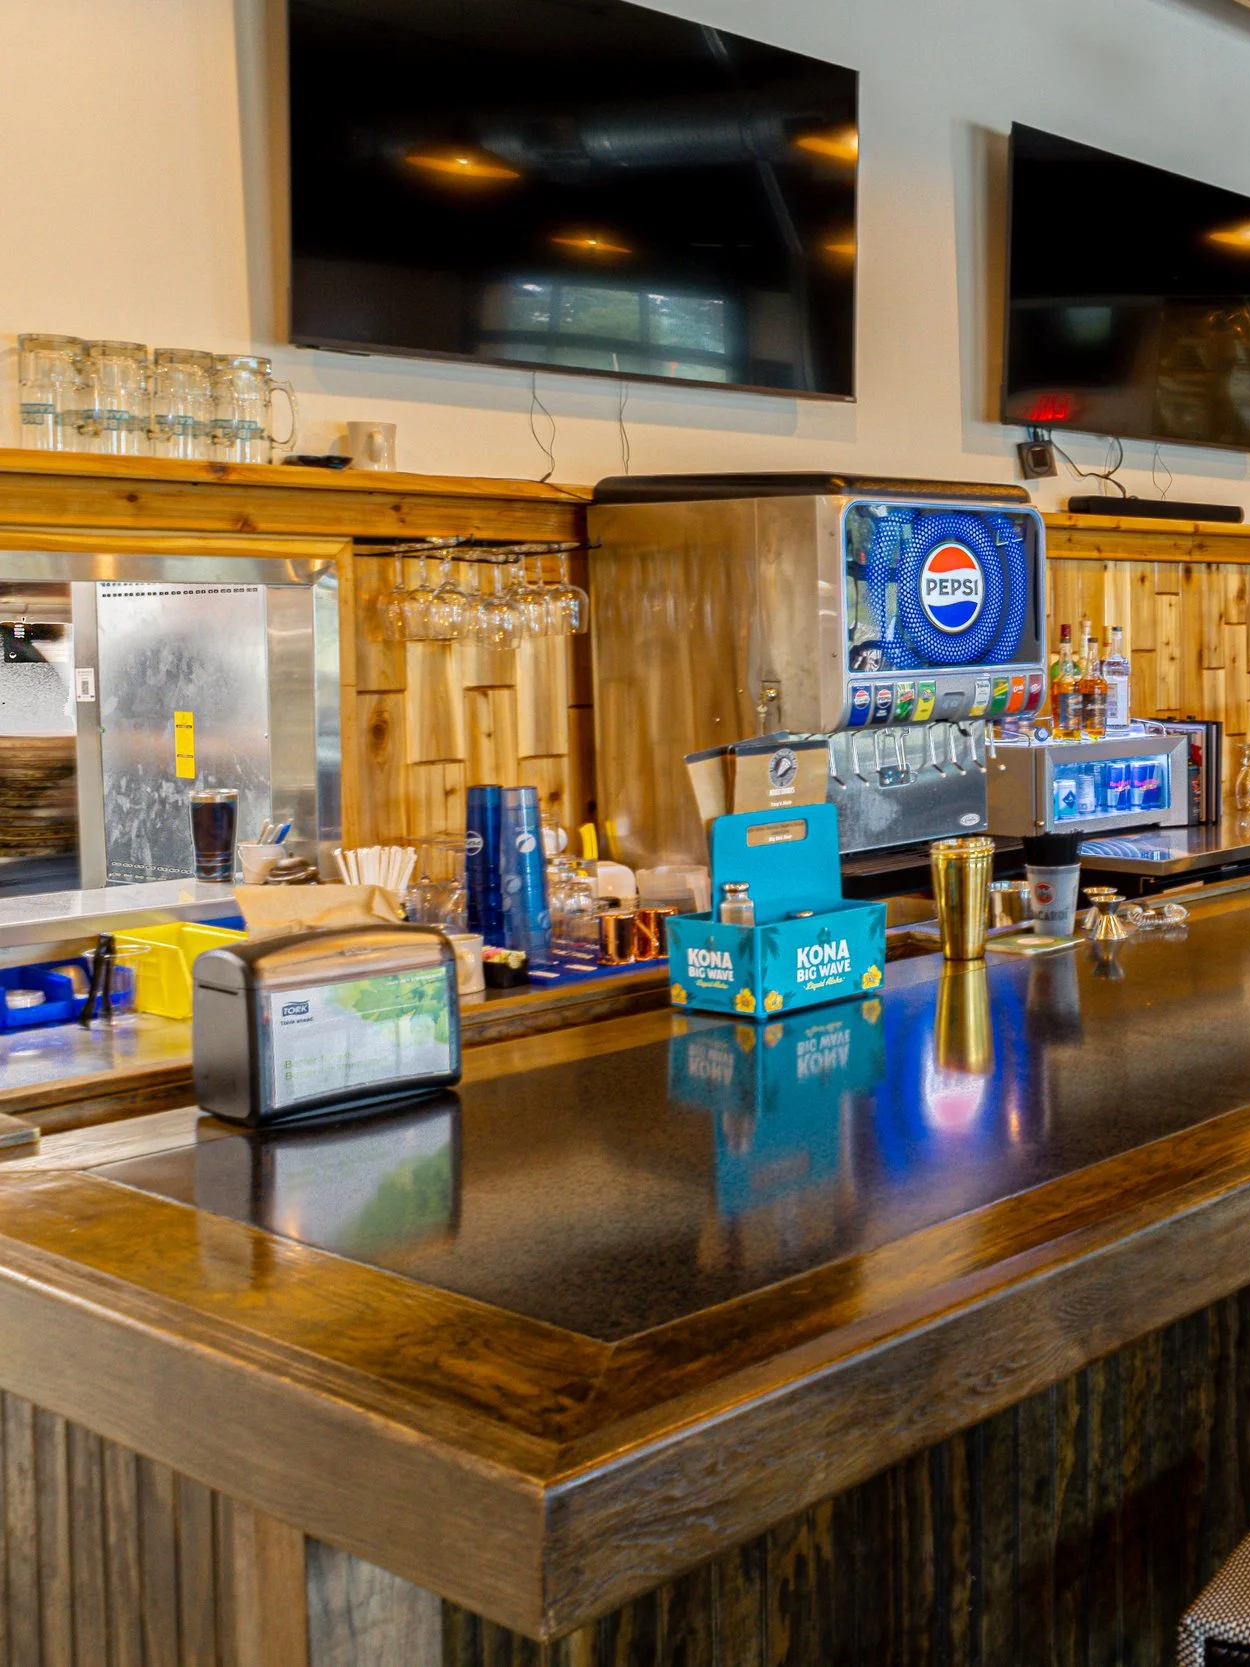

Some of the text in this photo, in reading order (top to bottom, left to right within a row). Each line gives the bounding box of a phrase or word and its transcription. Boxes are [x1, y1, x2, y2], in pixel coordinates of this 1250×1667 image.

[926, 578, 979, 597] PEPSI
[687, 948, 733, 969] KONA
[797, 939, 850, 968] KONA
[688, 966, 734, 982] BIG WAVE
[797, 960, 852, 983] BIG WAVE
[283, 1004, 309, 1015] TORK
